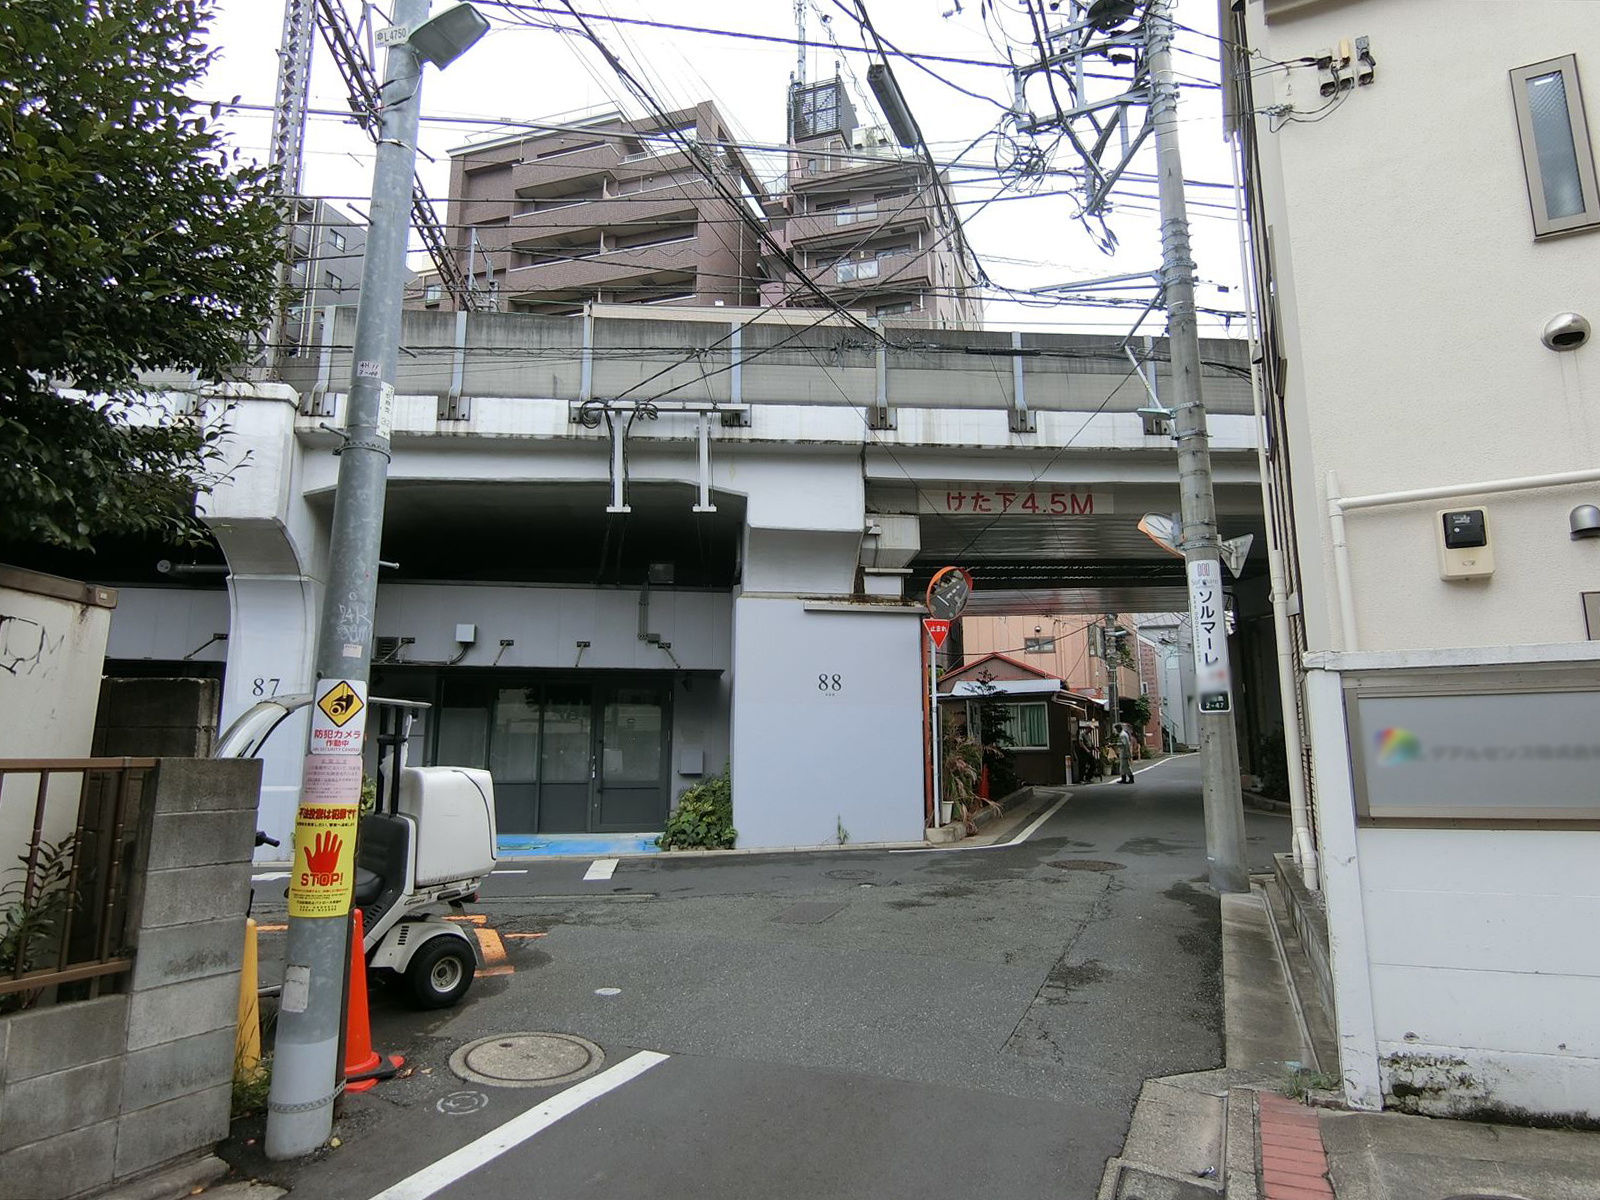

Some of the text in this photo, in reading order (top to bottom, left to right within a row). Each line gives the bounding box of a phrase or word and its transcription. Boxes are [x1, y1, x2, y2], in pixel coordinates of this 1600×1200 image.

[1199, 590, 1219, 667] ソルマーレ
[252, 677, 281, 697] 87
[818, 673, 842, 692] 88
[314, 729, 361, 740] 防犯カメラ
[325, 739, 350, 747] 作動中
[300, 872, 343, 886] STOP!
